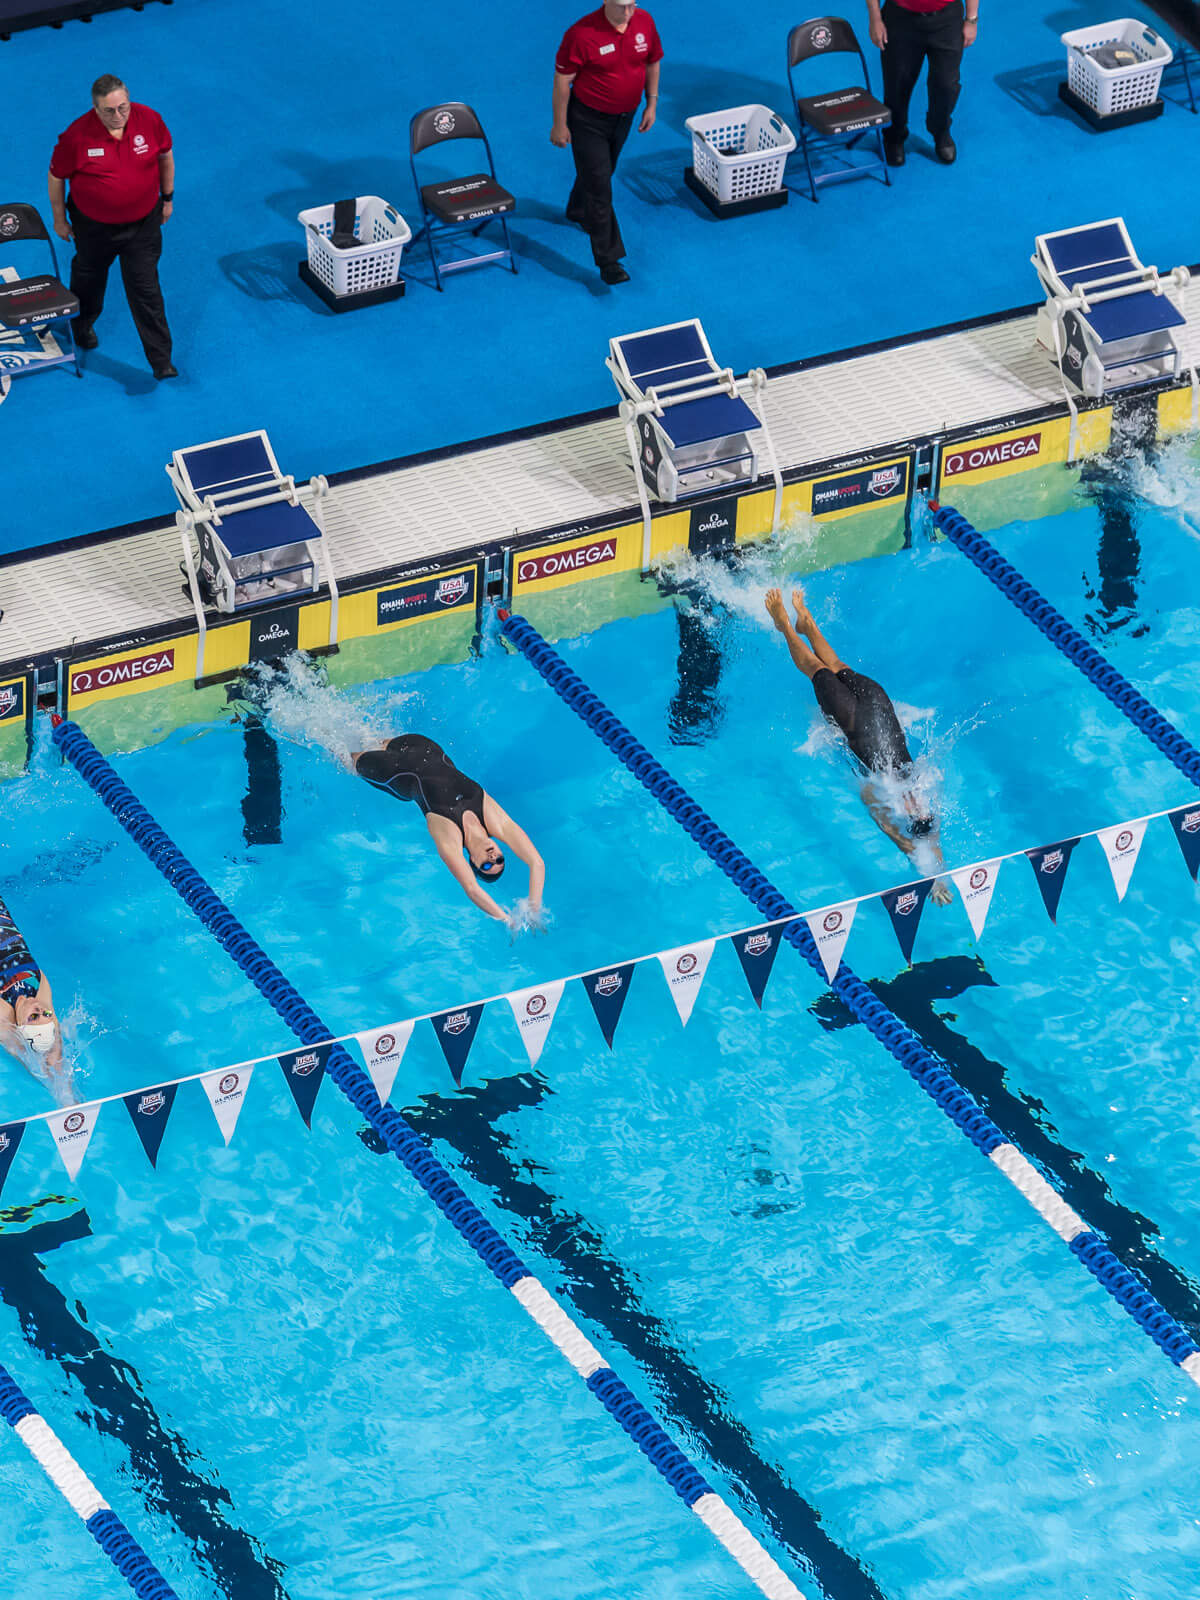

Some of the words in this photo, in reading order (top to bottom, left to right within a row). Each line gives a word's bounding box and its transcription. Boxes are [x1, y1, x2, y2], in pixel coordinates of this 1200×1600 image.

[969, 437, 1039, 468] OMEGA
[875, 471, 894, 482] USA
[698, 518, 729, 532] OMEGA
[543, 543, 614, 574] OMEGA
[442, 580, 461, 591] USA
[258, 629, 290, 642] OMEGA
[98, 654, 173, 685] OMEGA
[750, 935, 766, 944] USA
[601, 976, 616, 984] USA
[449, 1014, 465, 1024] USA
[298, 1056, 313, 1065] USA
[144, 1095, 159, 1104] USA
